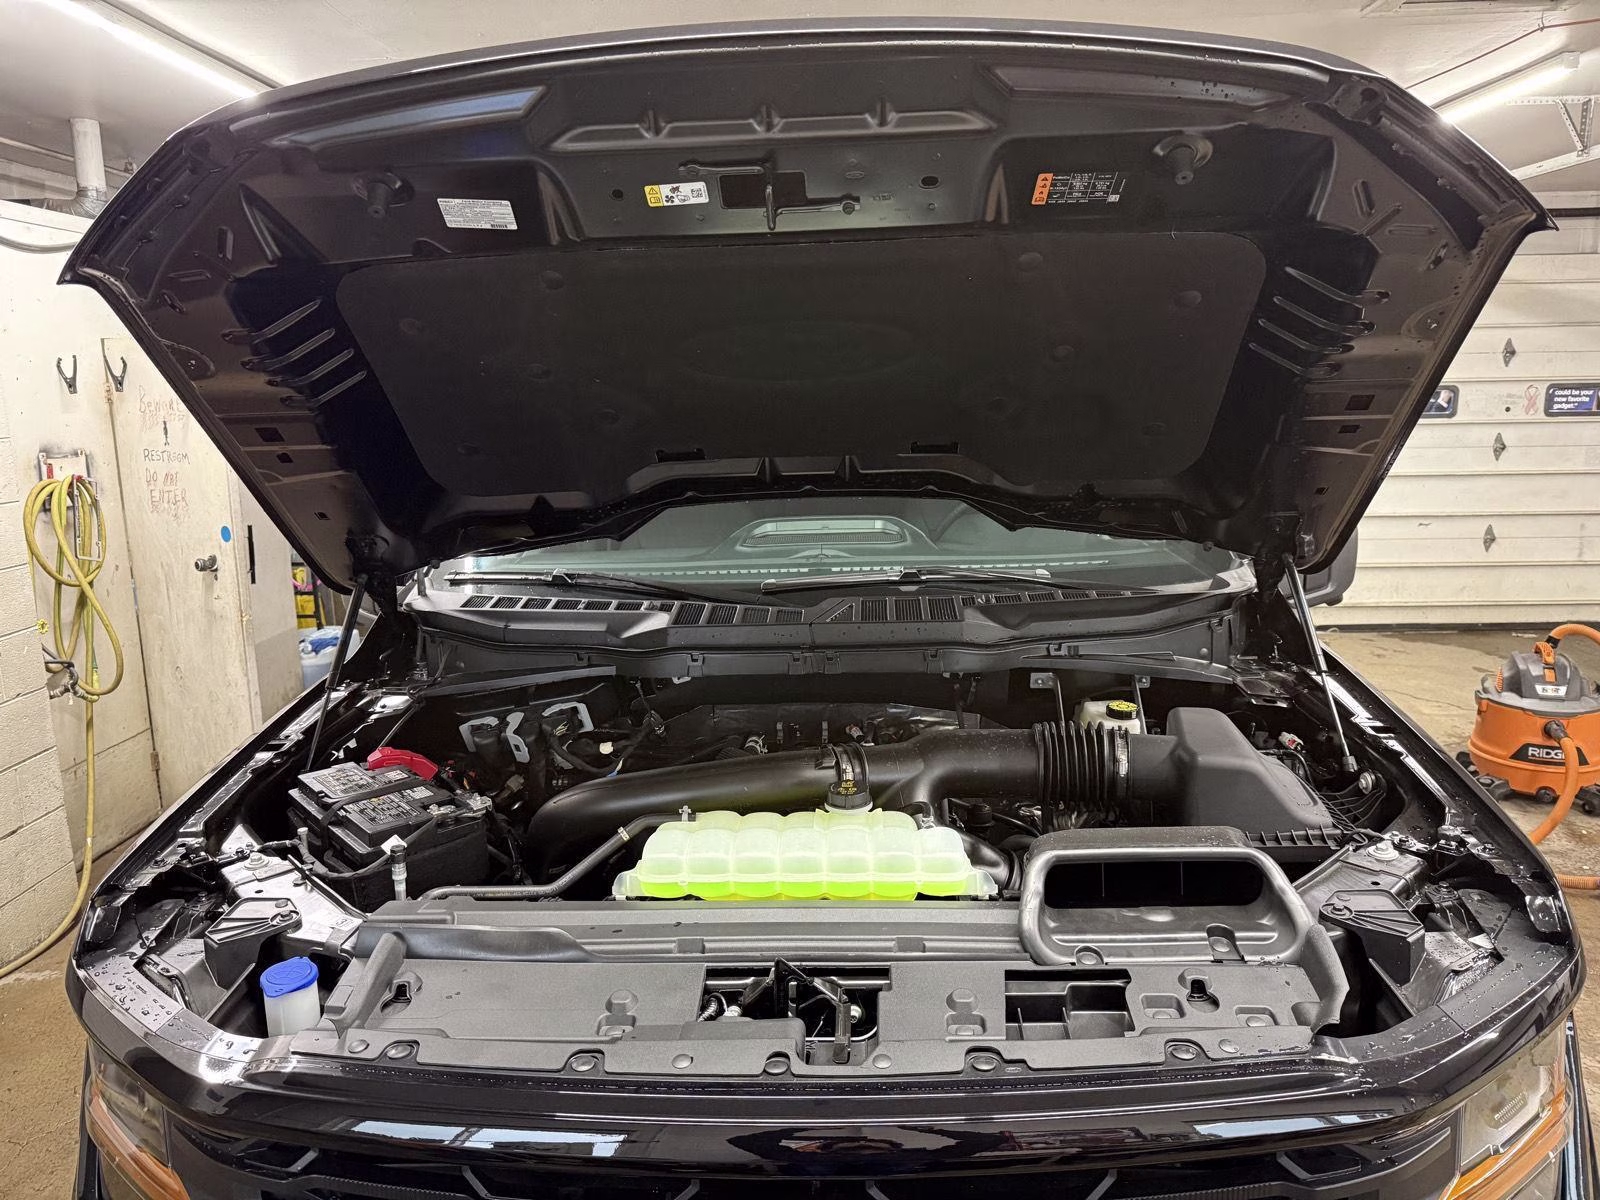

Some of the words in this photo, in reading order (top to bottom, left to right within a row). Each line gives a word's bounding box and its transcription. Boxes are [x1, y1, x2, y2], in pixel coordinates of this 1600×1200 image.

[143, 448, 190, 465] RESTROOM
[145, 467, 158, 483] DO
[150, 489, 189, 507] ENTER
